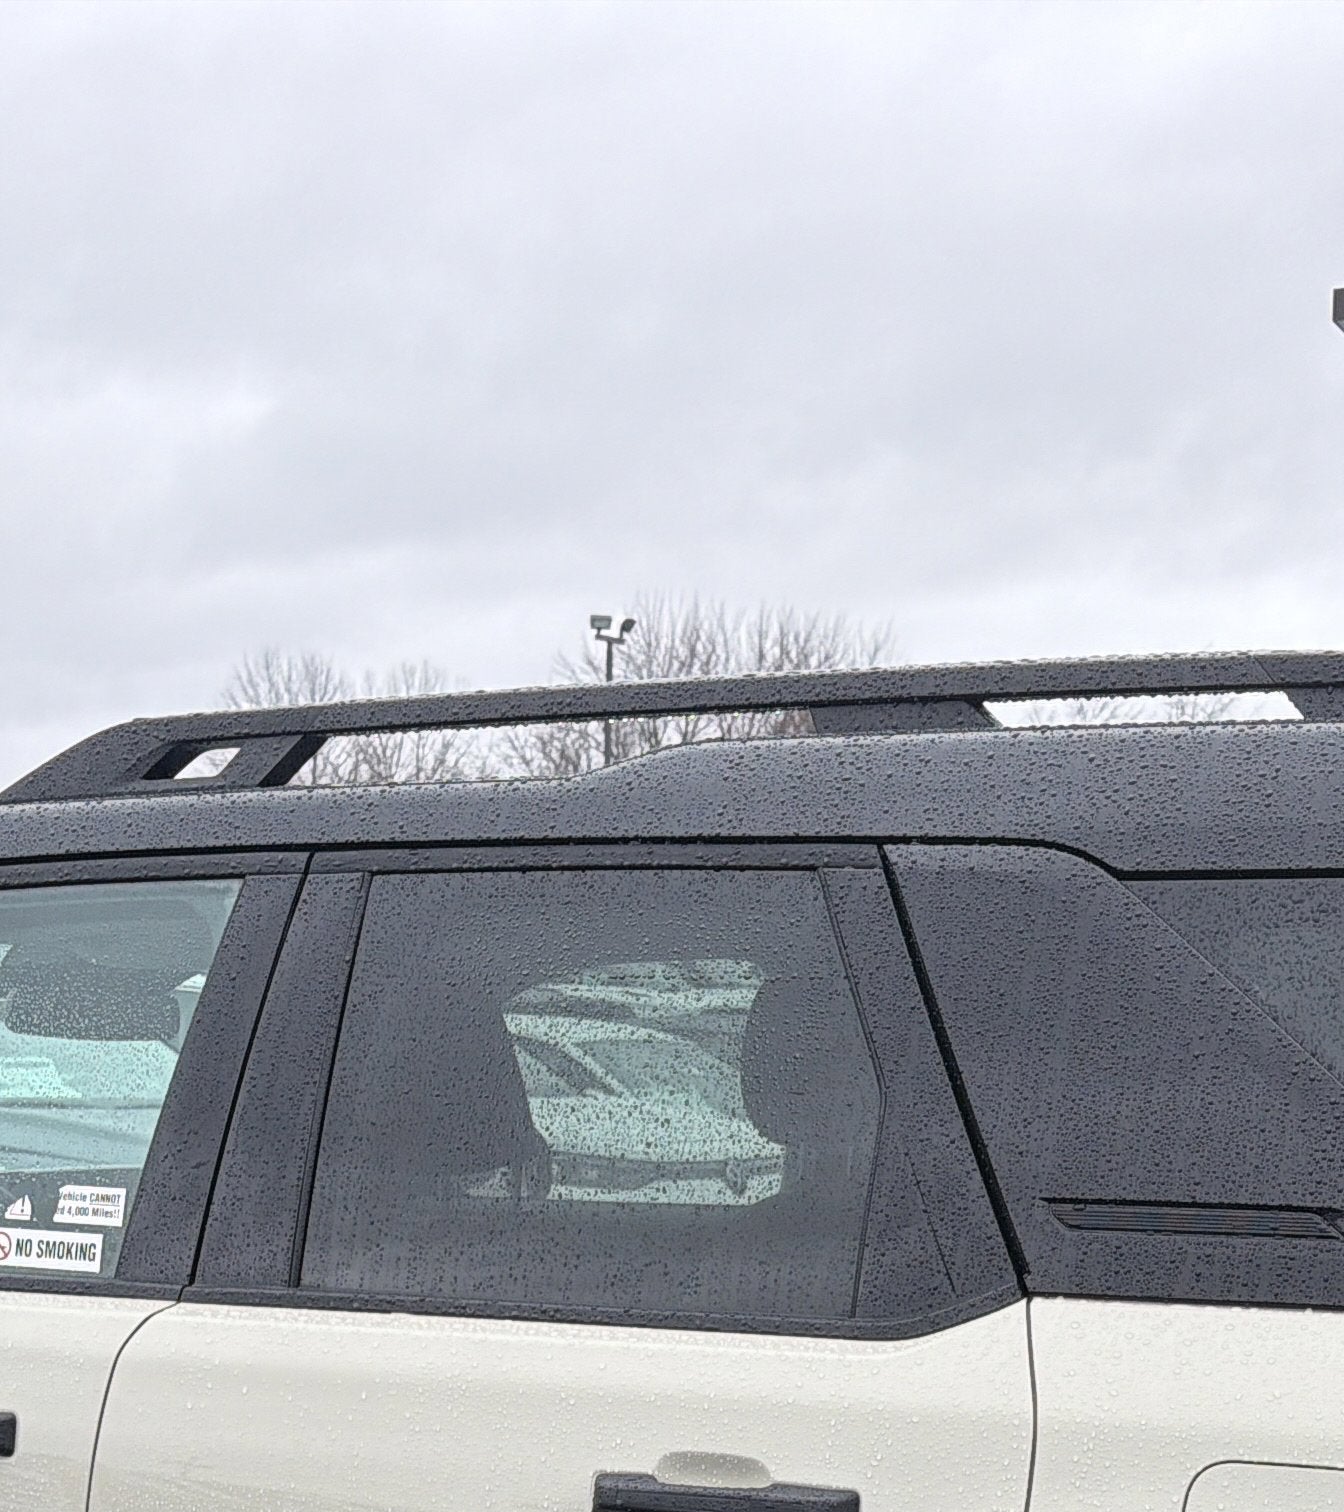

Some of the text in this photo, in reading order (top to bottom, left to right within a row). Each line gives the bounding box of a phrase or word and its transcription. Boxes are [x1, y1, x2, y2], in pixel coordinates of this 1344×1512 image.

[89, 1192, 121, 1205] CANNOT
[67, 1206, 89, 1218] 4,000
[15, 1237, 97, 1263] NO SMOKING
